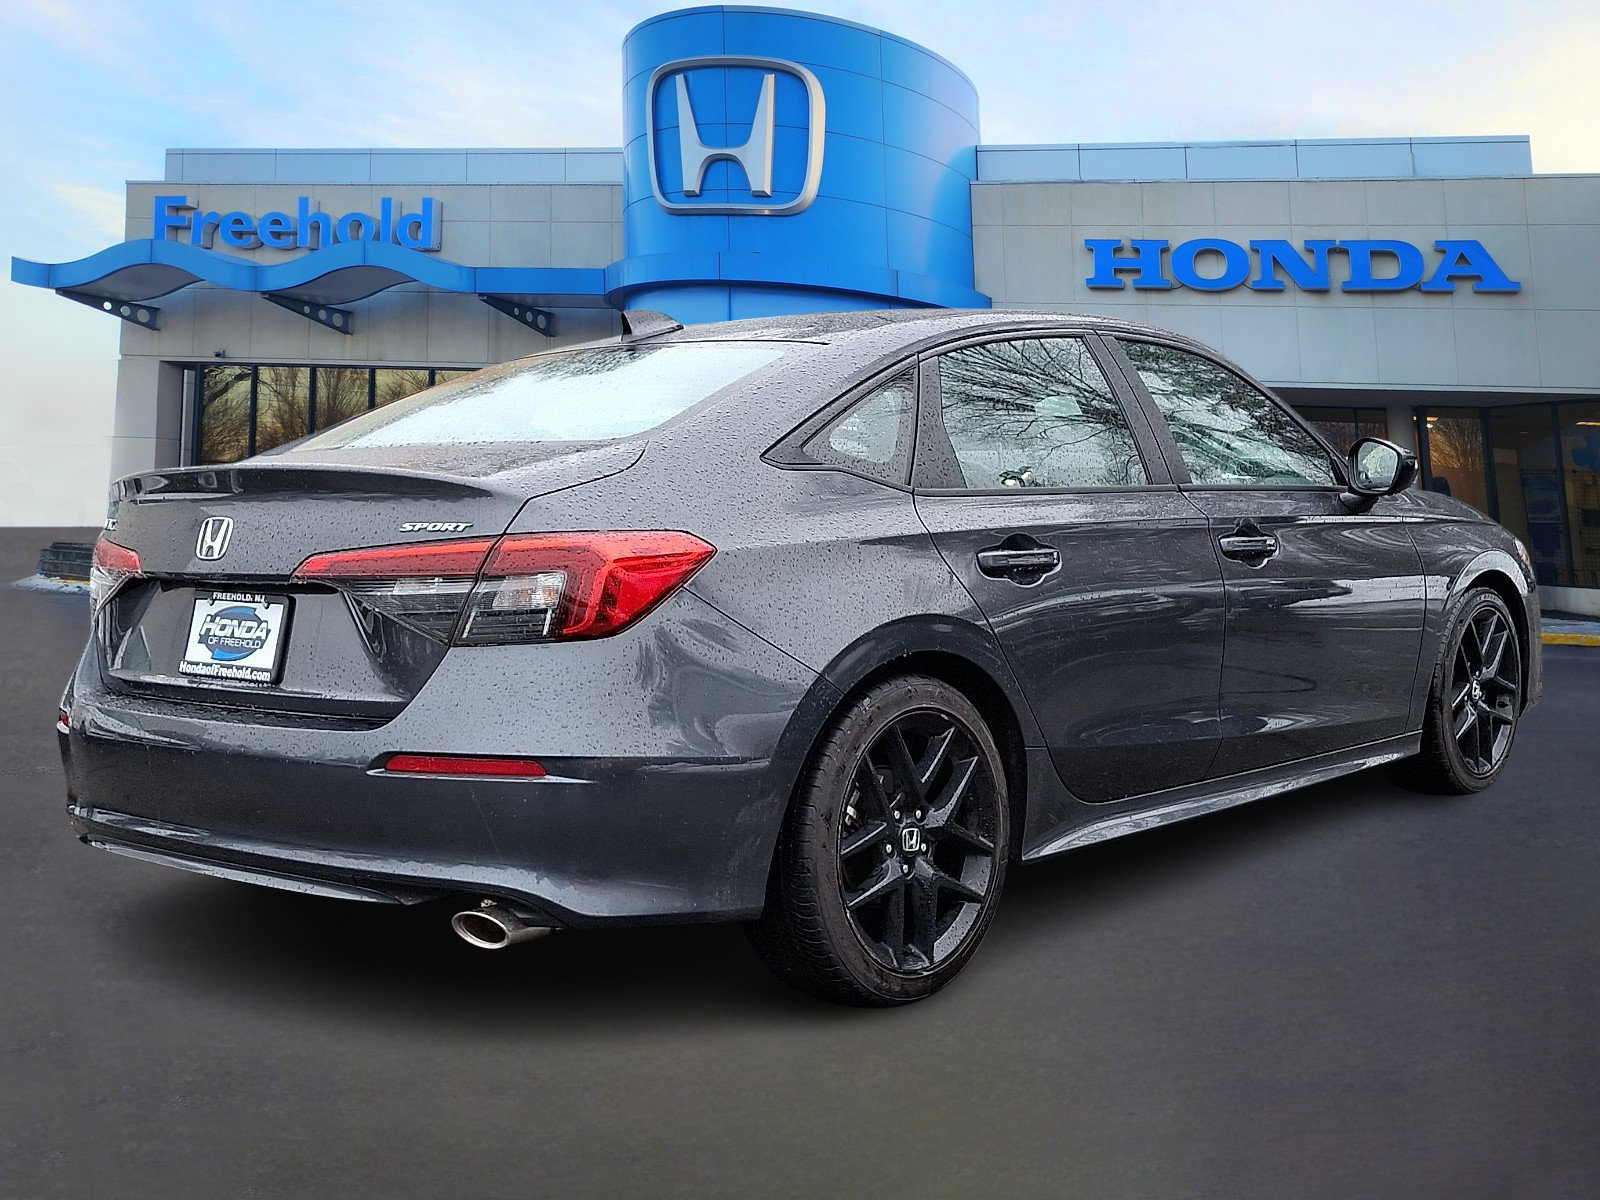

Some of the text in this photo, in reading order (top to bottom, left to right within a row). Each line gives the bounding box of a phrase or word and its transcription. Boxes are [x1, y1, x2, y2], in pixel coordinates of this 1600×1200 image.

[153, 195, 443, 251] Freehold
[1084, 238, 1521, 292] HONDA
[399, 522, 474, 532] SPORT
[199, 614, 269, 640] HONDA
[207, 636, 261, 648] OF FREEHOLD
[179, 660, 271, 681] HondaofFreehold.com
